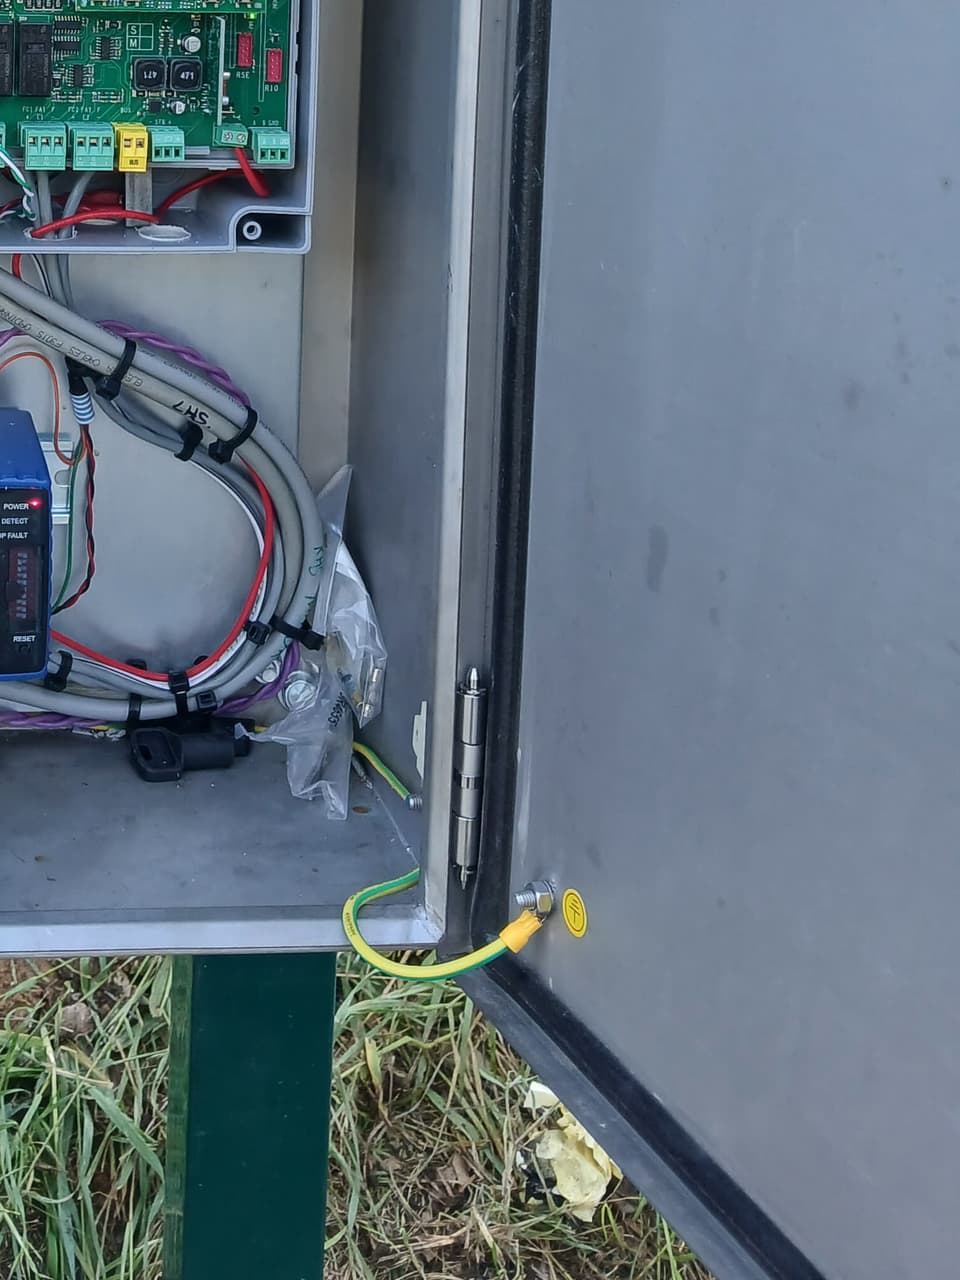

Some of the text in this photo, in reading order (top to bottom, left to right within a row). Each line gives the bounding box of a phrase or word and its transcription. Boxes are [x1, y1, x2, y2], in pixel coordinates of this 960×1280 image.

[3, 503, 29, 511] POWER
[1, 517, 28, 525] DETECT
[8, 531, 28, 540] FAULT
[12, 634, 36, 643] RESET
